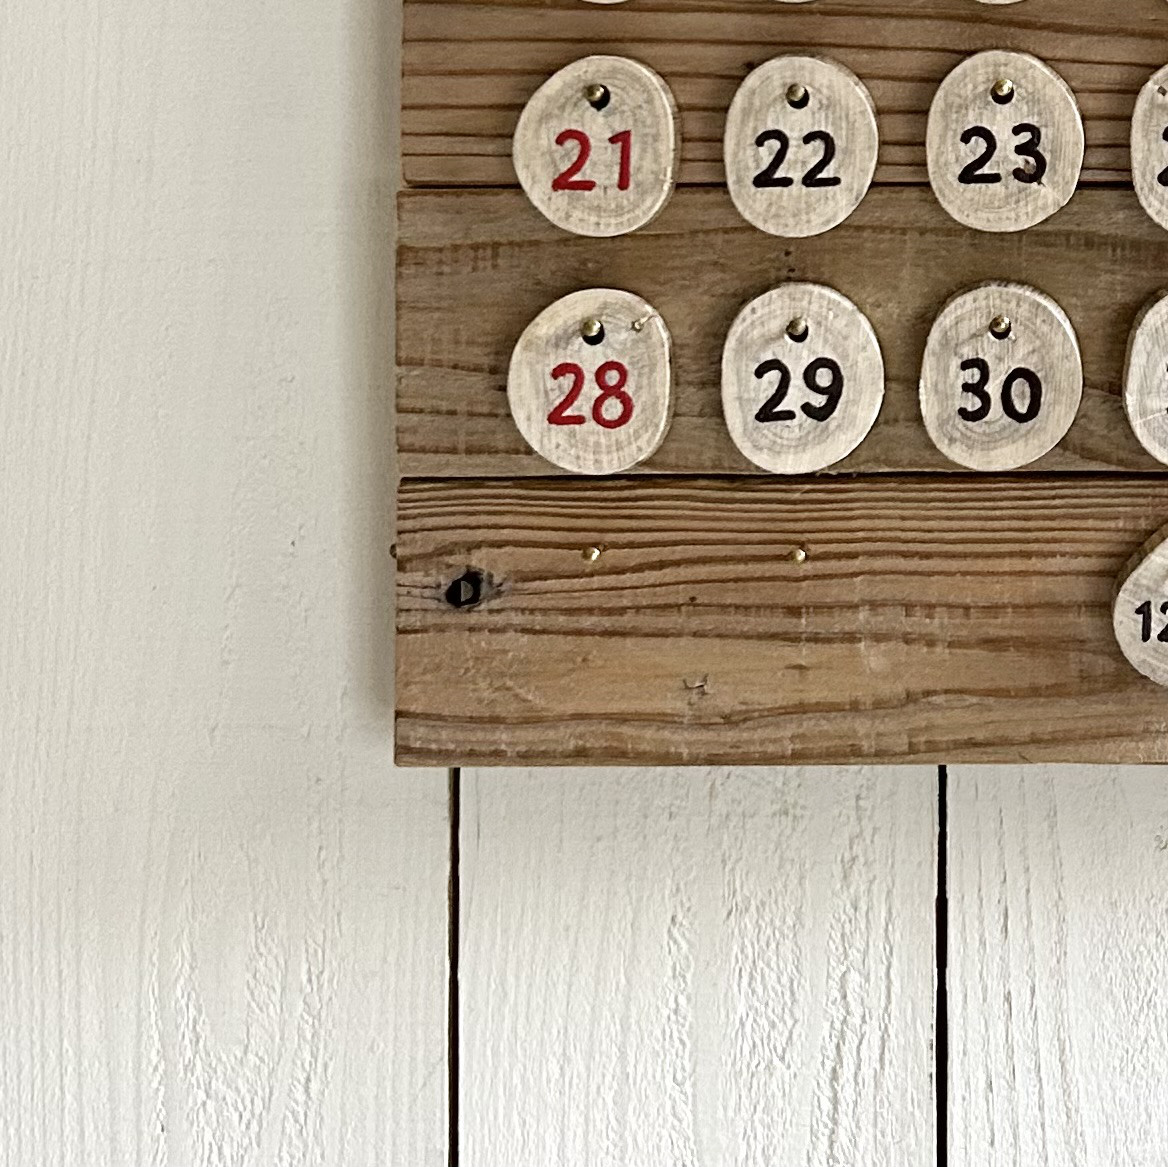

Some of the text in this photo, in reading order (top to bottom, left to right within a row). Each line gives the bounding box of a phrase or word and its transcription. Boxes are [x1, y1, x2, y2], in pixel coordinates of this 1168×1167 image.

[552, 129, 631, 192] 21
[753, 129, 841, 188] 22
[958, 123, 1047, 185] 23
[547, 361, 633, 429] 28
[754, 358, 843, 423] 29
[958, 357, 1042, 423] 30
